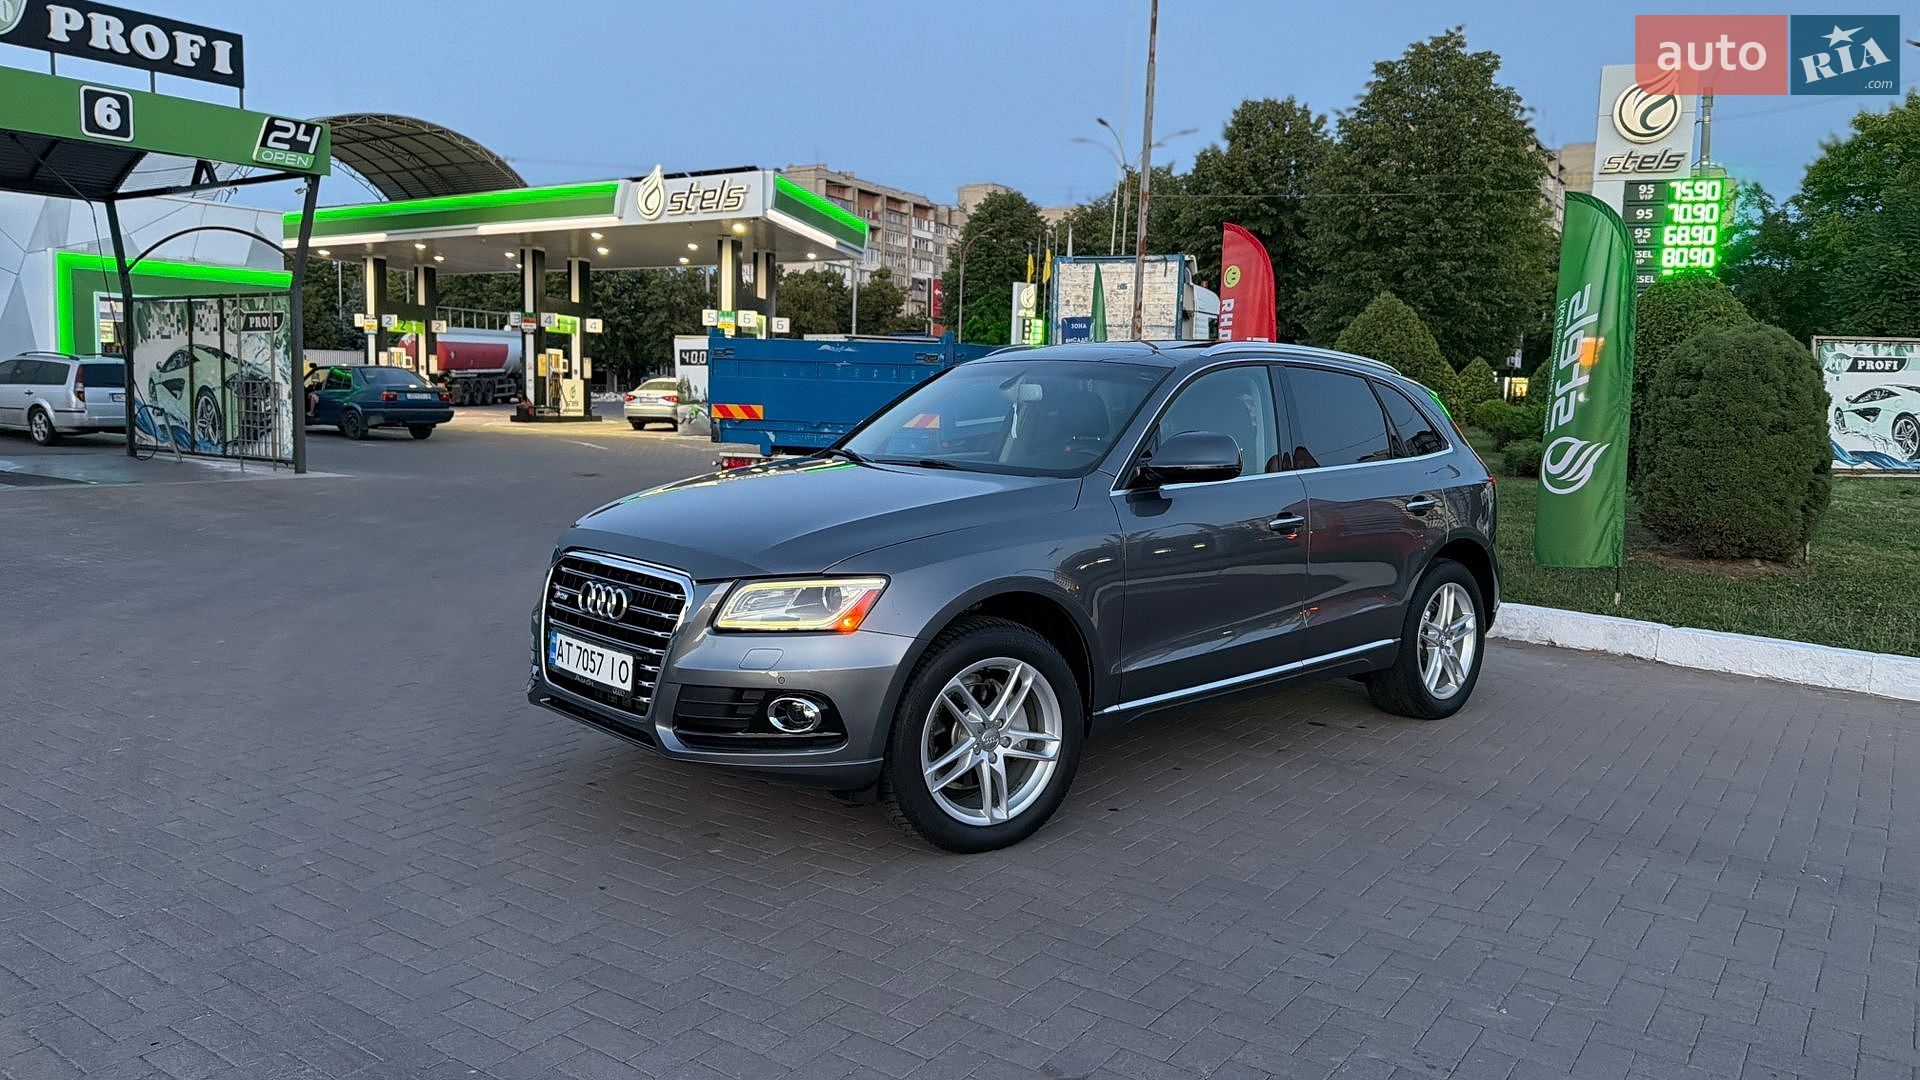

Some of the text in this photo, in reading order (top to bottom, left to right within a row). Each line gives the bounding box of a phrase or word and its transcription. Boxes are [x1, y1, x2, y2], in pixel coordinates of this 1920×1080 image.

[46, 4, 235, 76] PROFI
[94, 96, 122, 131] 6
[267, 119, 322, 155] 24
[261, 150, 310, 168] OPEN
[1600, 149, 1687, 174] stels
[1638, 184, 1655, 195] 95
[666, 178, 748, 215] stels
[1636, 208, 1654, 220] 95
[1634, 227, 1652, 239] 95
[249, 316, 278, 328] PROI
[385, 315, 393, 325] 2
[544, 315, 552, 324] 4
[707, 312, 715, 323] 5
[743, 313, 751, 324] 6
[434, 323, 441, 331] 2
[776, 320, 784, 330] 6
[1857, 360, 1899, 370] PROFI
[557, 639, 630, 684] AT 7057 IO
